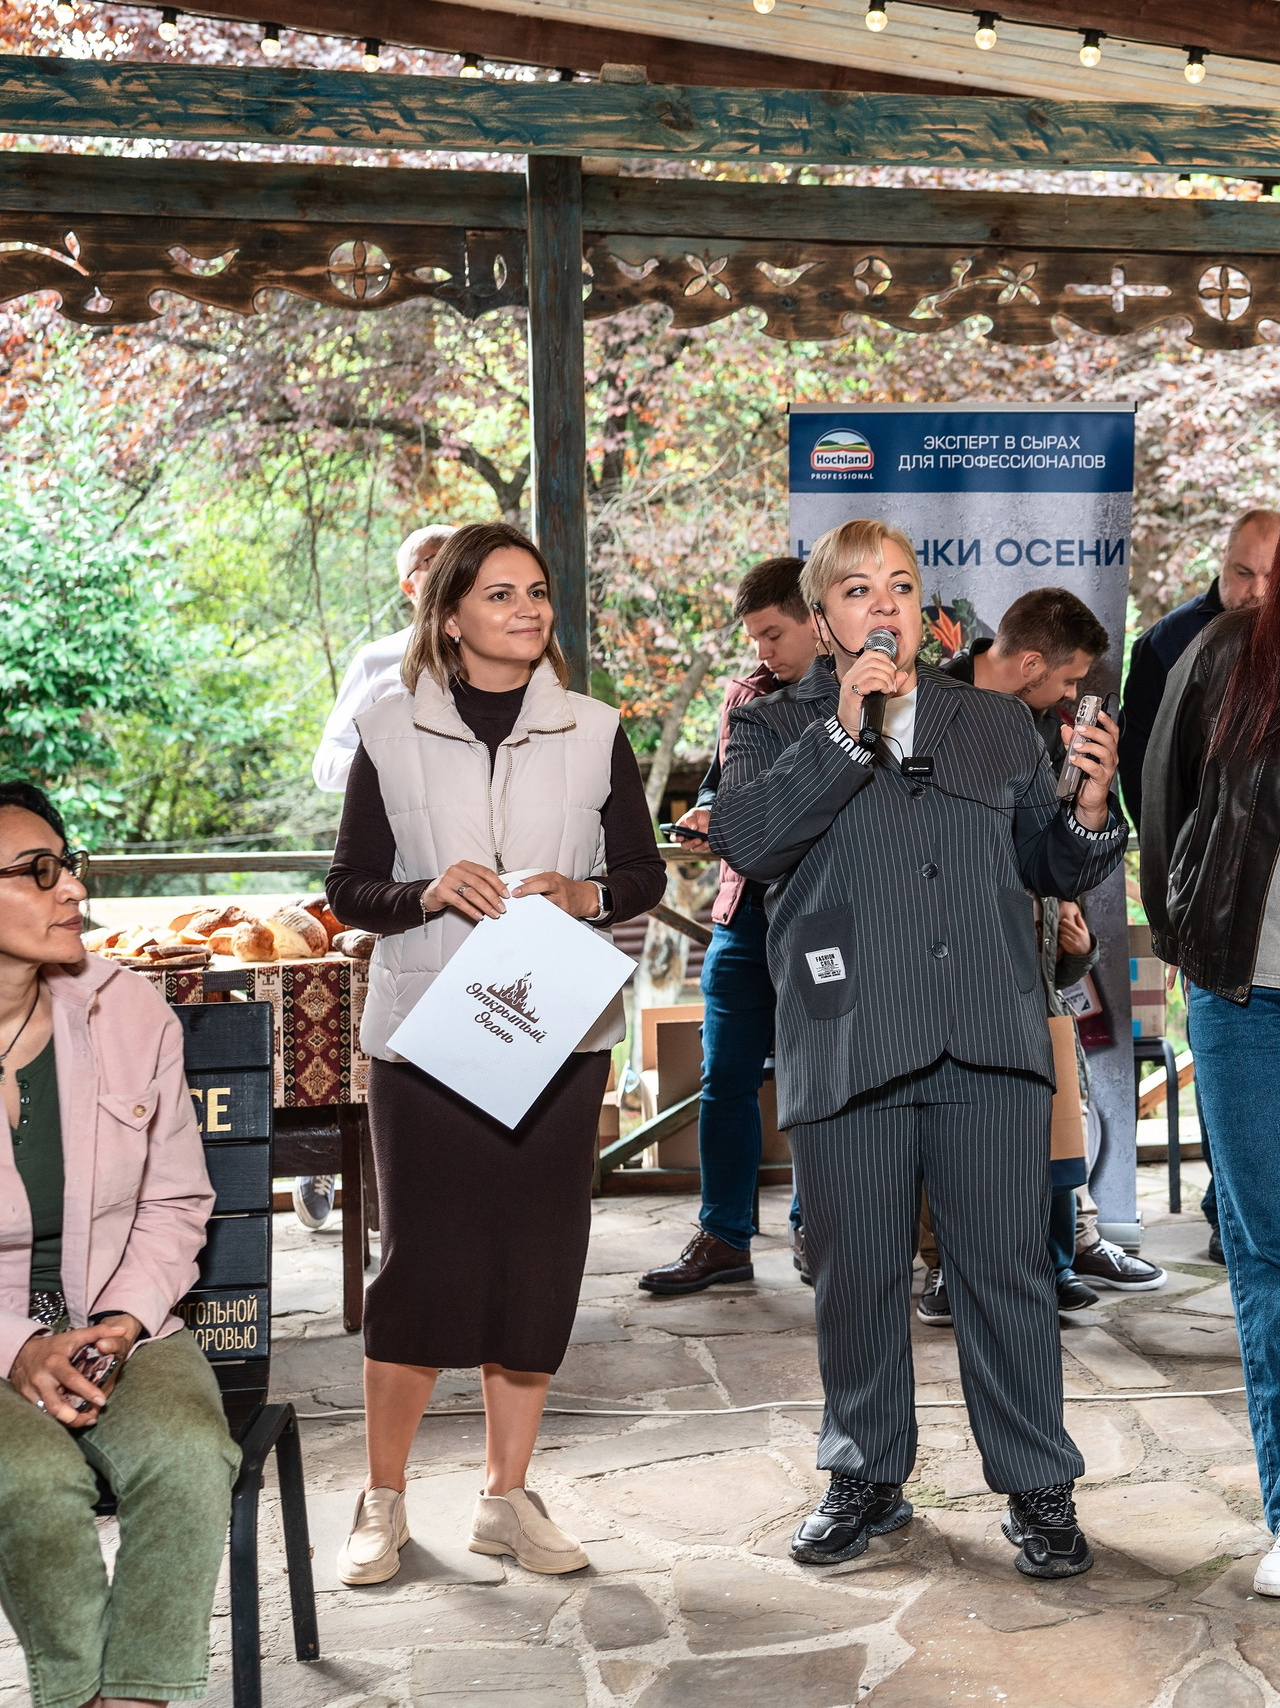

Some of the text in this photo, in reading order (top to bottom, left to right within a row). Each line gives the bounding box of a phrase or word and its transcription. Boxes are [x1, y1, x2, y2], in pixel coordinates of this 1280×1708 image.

[923, 435, 1081, 450] ЭКСПЕРТ В СЫРАХ
[816, 454, 869, 465] Hochland
[898, 454, 1106, 471] ДЛЯ ПРОФЕССИОНАЛОВ
[810, 472, 874, 480] PROFESSIONAL
[797, 538, 1125, 567] ННКИ ОСЕНИ
[465, 982, 548, 1044] Открытый
[474, 1011, 514, 1044] Огонь
[172, 1294, 258, 1325] ОГОЛЬНОЙ
[190, 1325, 258, 1351] ОРОВЬЮ
